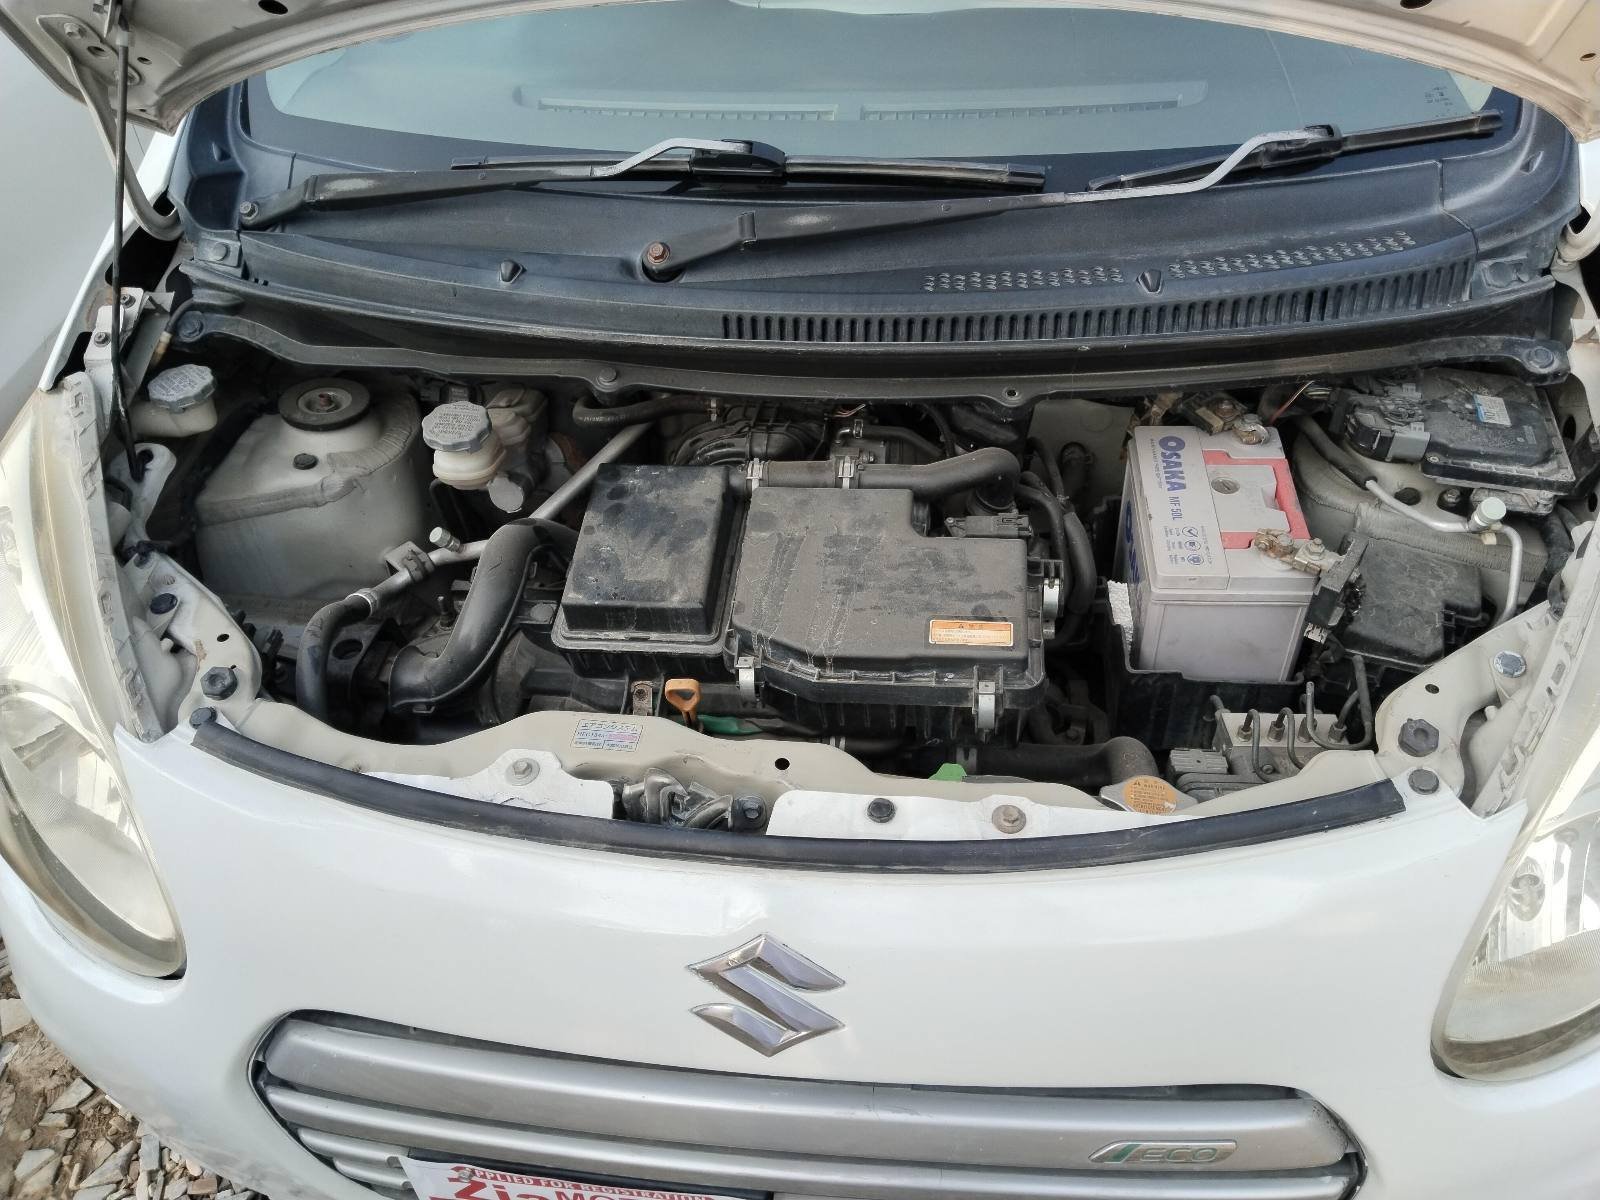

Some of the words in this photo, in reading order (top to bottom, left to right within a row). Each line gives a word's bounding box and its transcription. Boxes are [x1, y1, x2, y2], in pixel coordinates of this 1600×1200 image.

[1159, 436, 1187, 492] OSAKA
[1169, 496, 1181, 507] MF
[1171, 508, 1183, 521] 50L
[1139, 1147, 1218, 1163] ECO
[465, 1166, 534, 1185] PPLIED
[540, 1179, 575, 1190] FOR
[580, 1183, 707, 1200] REGISTRATION
